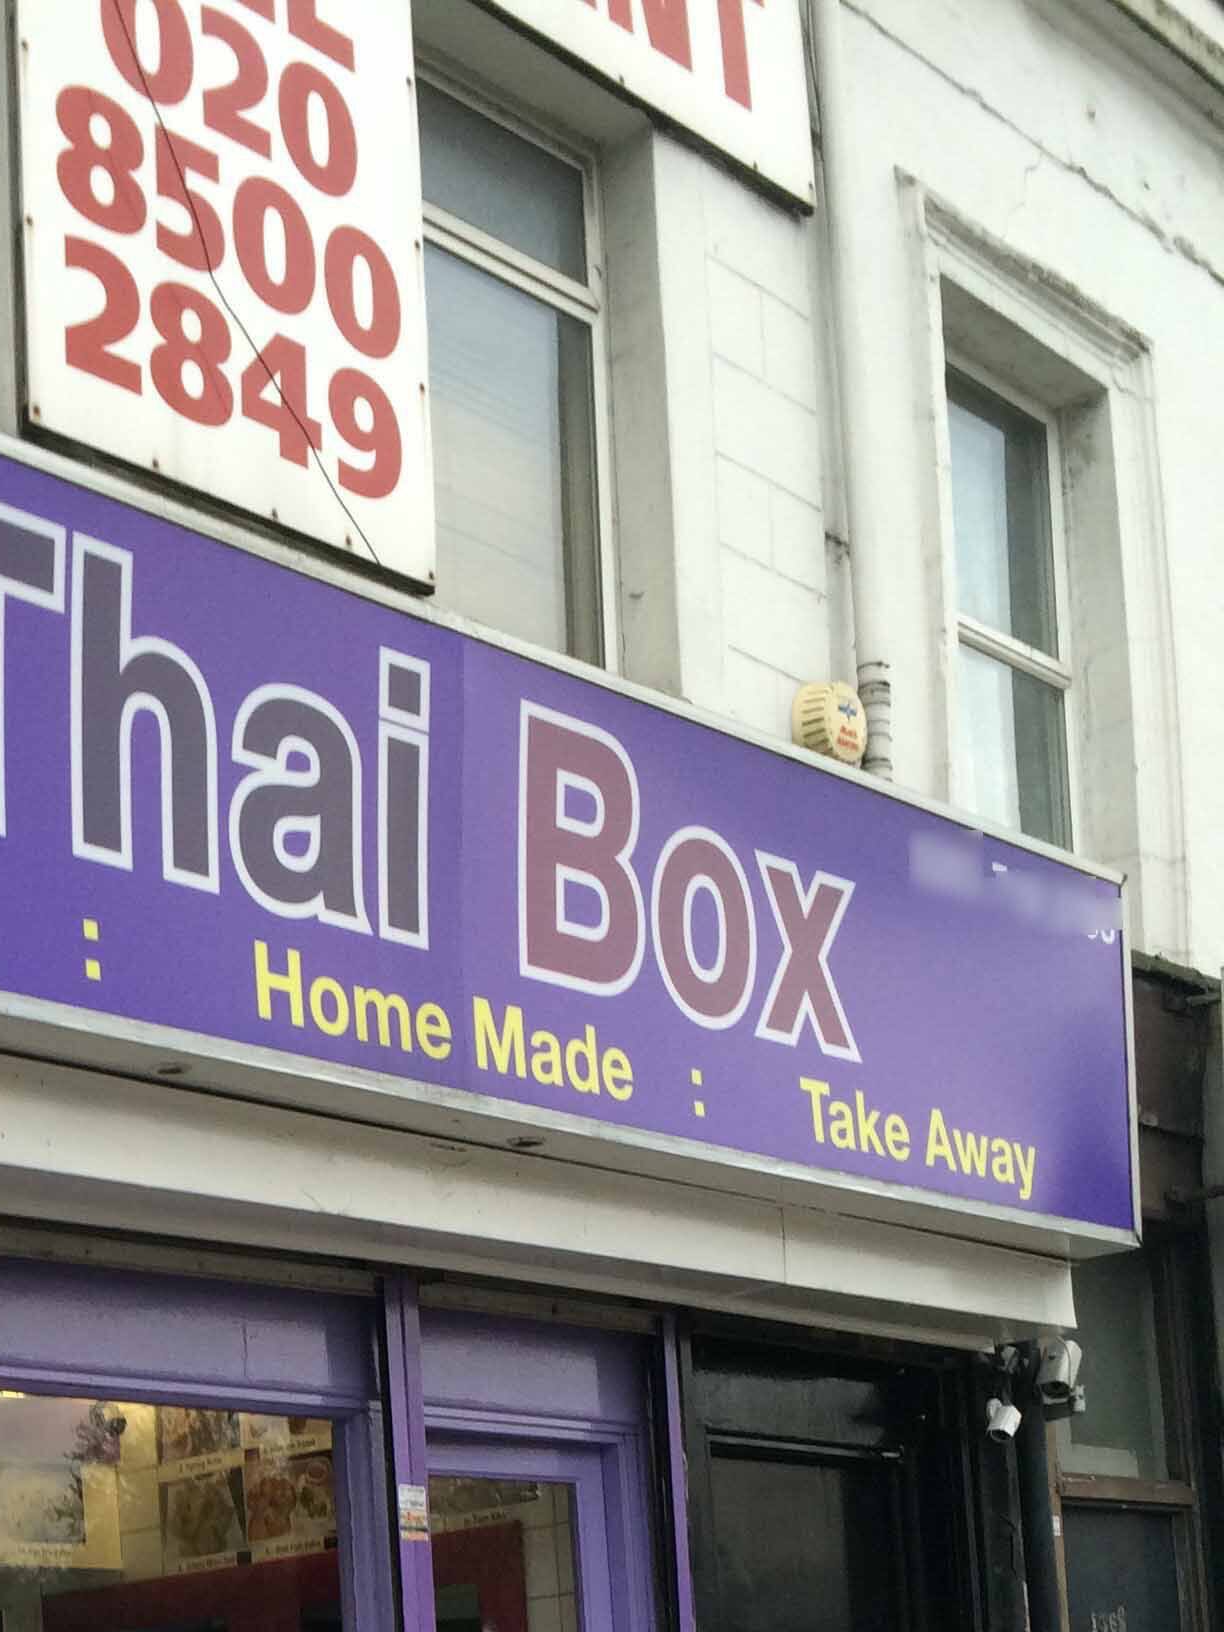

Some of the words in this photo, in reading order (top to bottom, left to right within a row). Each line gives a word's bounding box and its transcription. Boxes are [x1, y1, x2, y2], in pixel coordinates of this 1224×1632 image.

[55, 84, 402, 361] 8500
[100, 0, 358, 198] 020
[63, 235, 403, 500] 2849
[253, 939, 453, 1060] Home
[471, 995, 634, 1102] Made
[799, 1076, 911, 1162] Take
[925, 1108, 1037, 1201] Away
